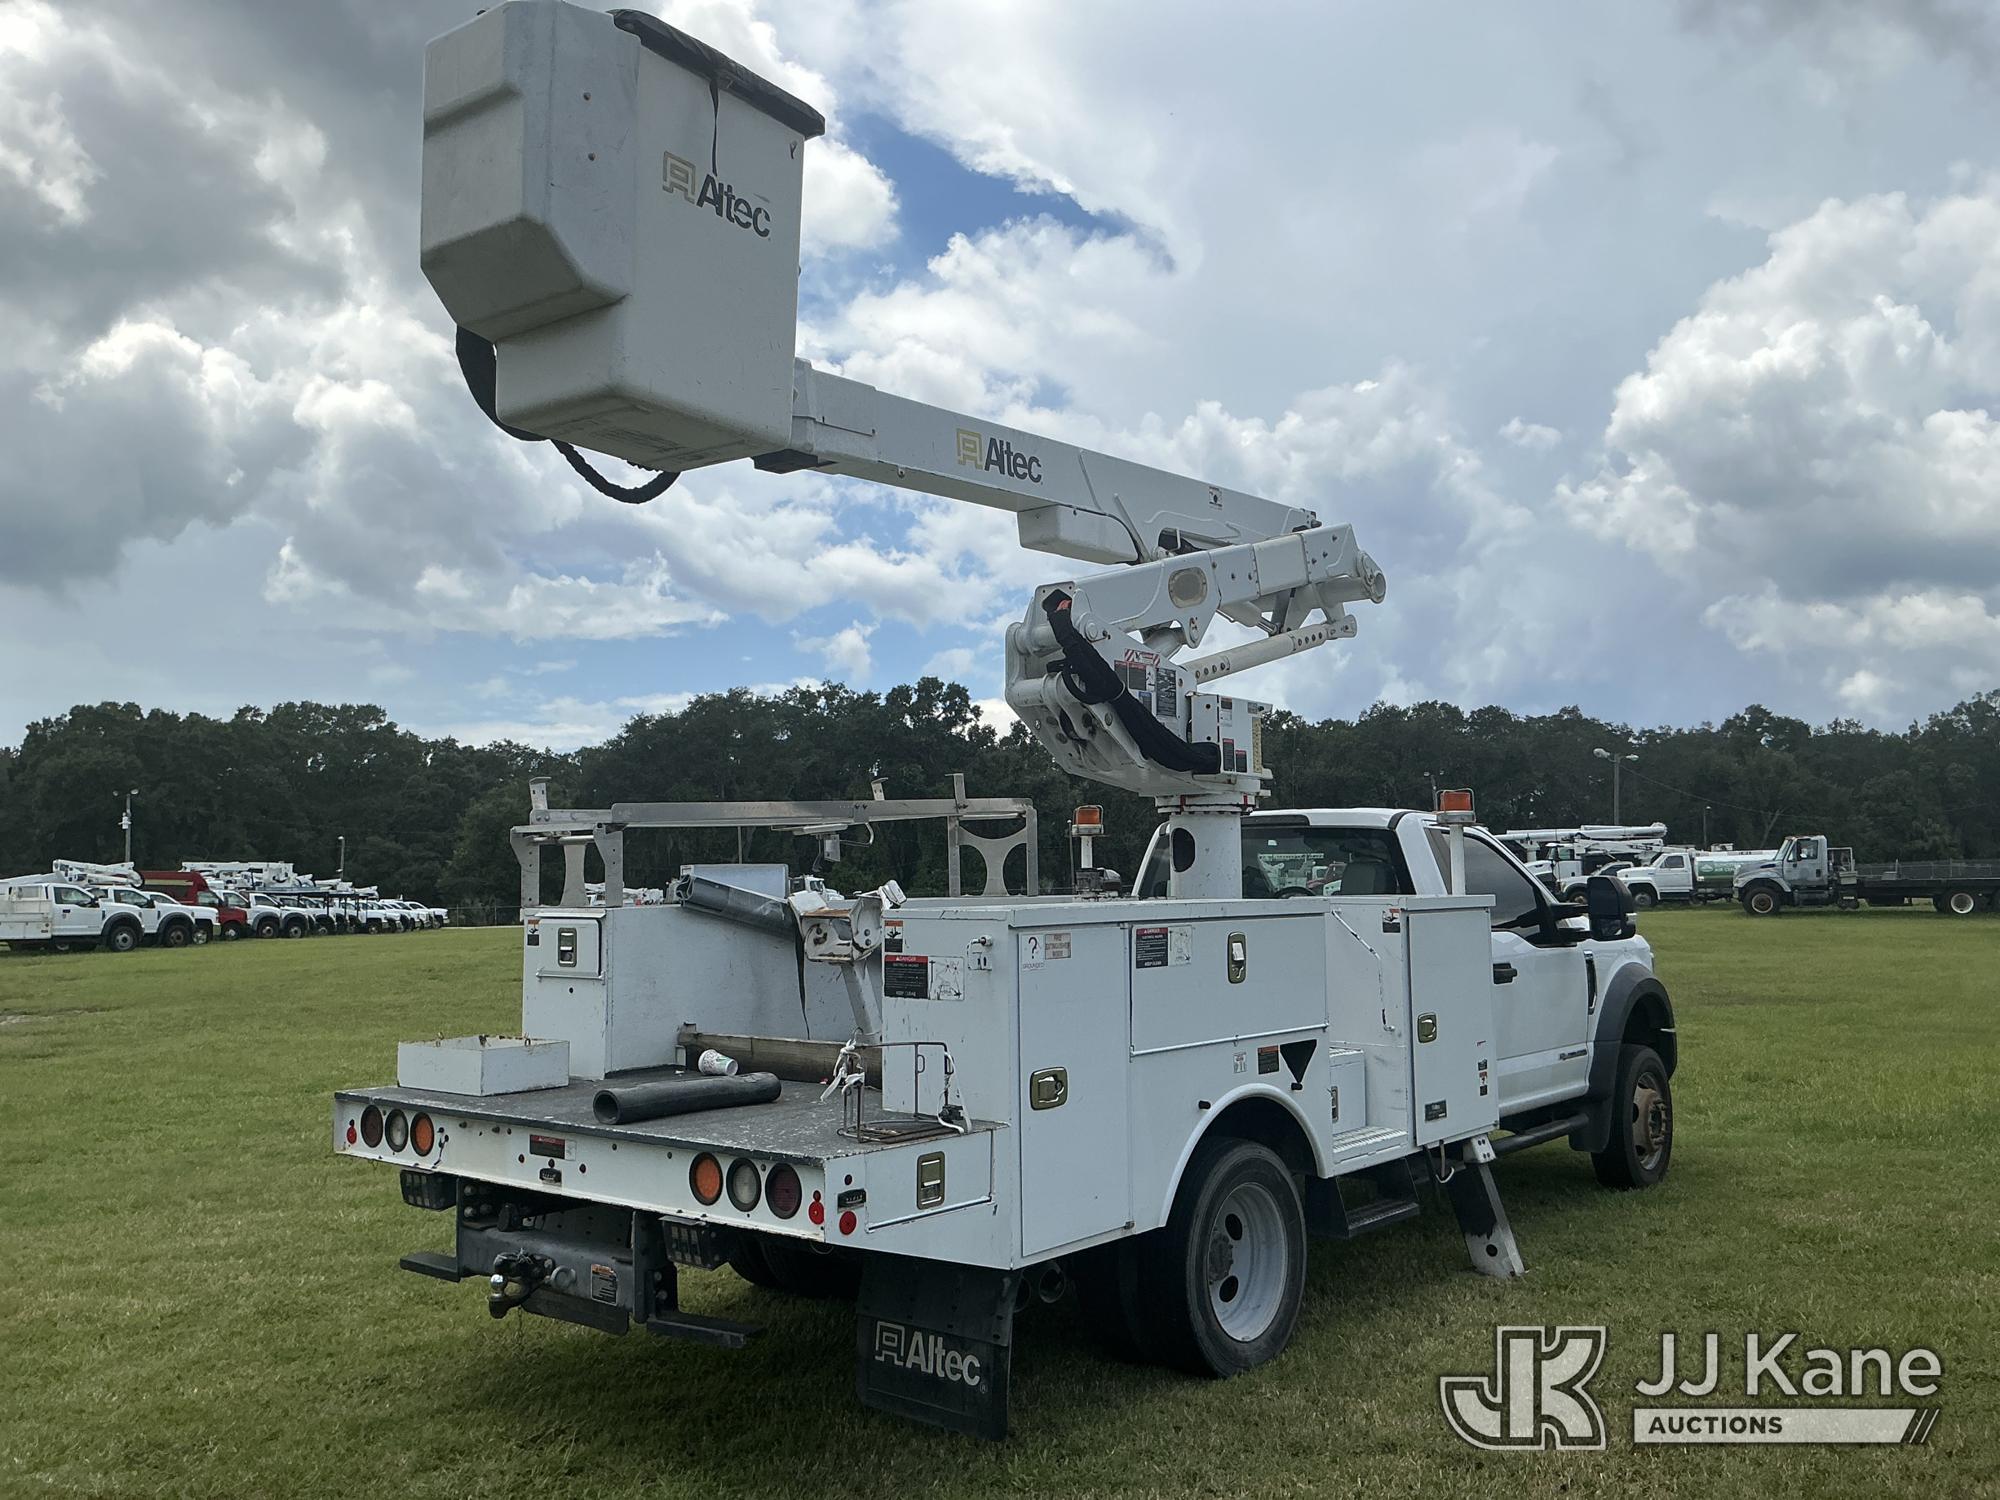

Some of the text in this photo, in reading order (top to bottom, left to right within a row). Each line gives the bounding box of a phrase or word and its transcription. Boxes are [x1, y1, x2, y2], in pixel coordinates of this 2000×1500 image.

[696, 174, 771, 238] Altec
[984, 437, 1042, 483] Altec
[905, 1331, 980, 1386] Altec
